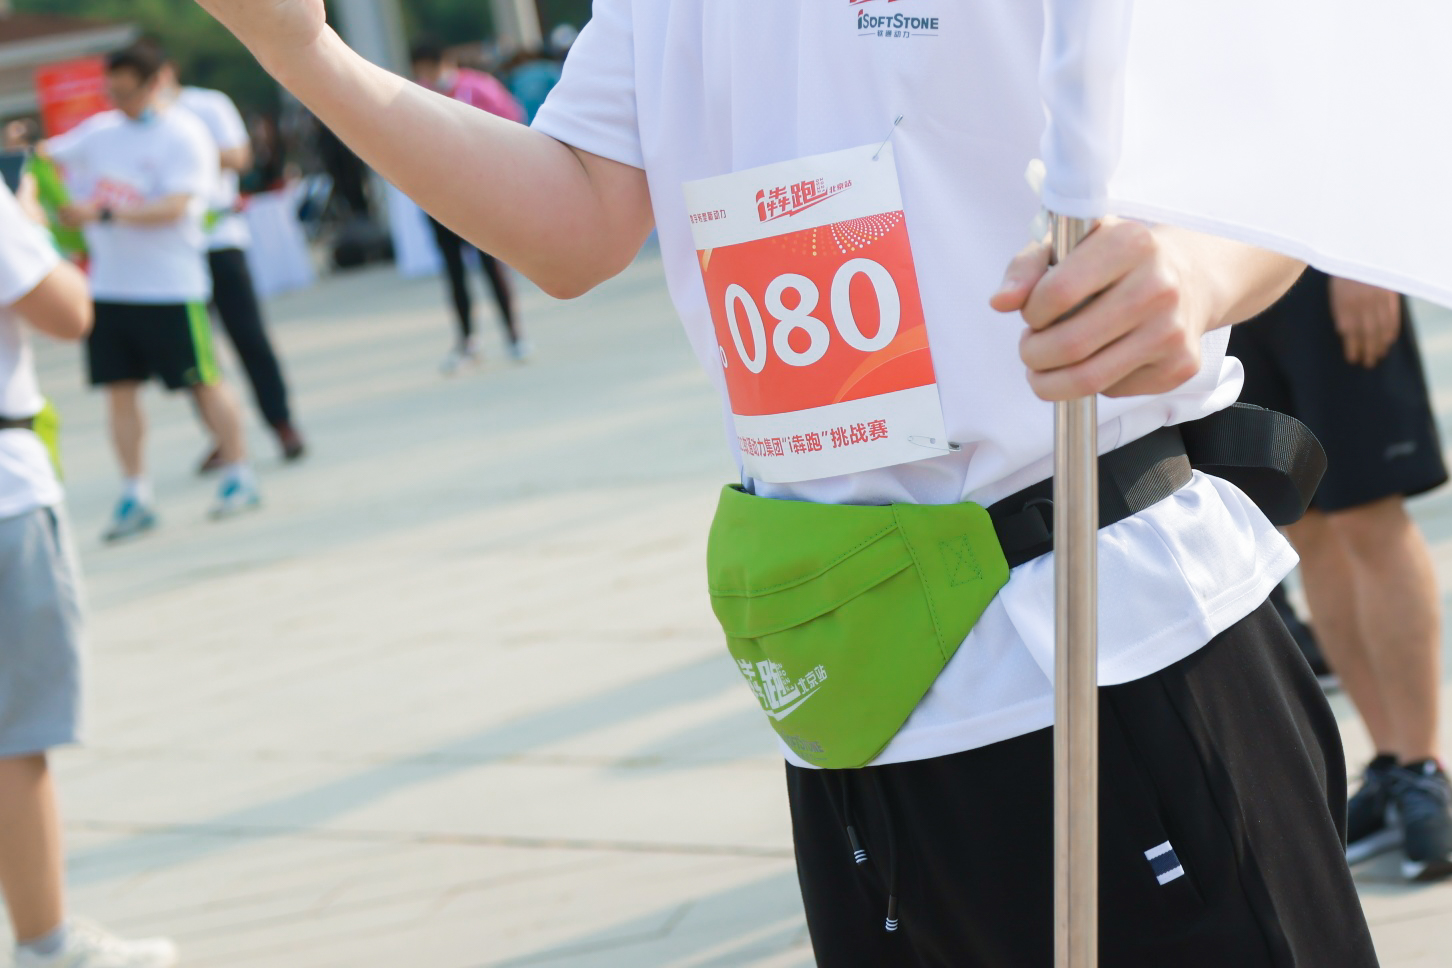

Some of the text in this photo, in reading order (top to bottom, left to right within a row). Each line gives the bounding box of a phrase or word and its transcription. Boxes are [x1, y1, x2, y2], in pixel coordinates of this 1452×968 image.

[877, 30, 910, 39] 软通动力
[725, 257, 901, 374] 080
[798, 664, 828, 695] 北京站
